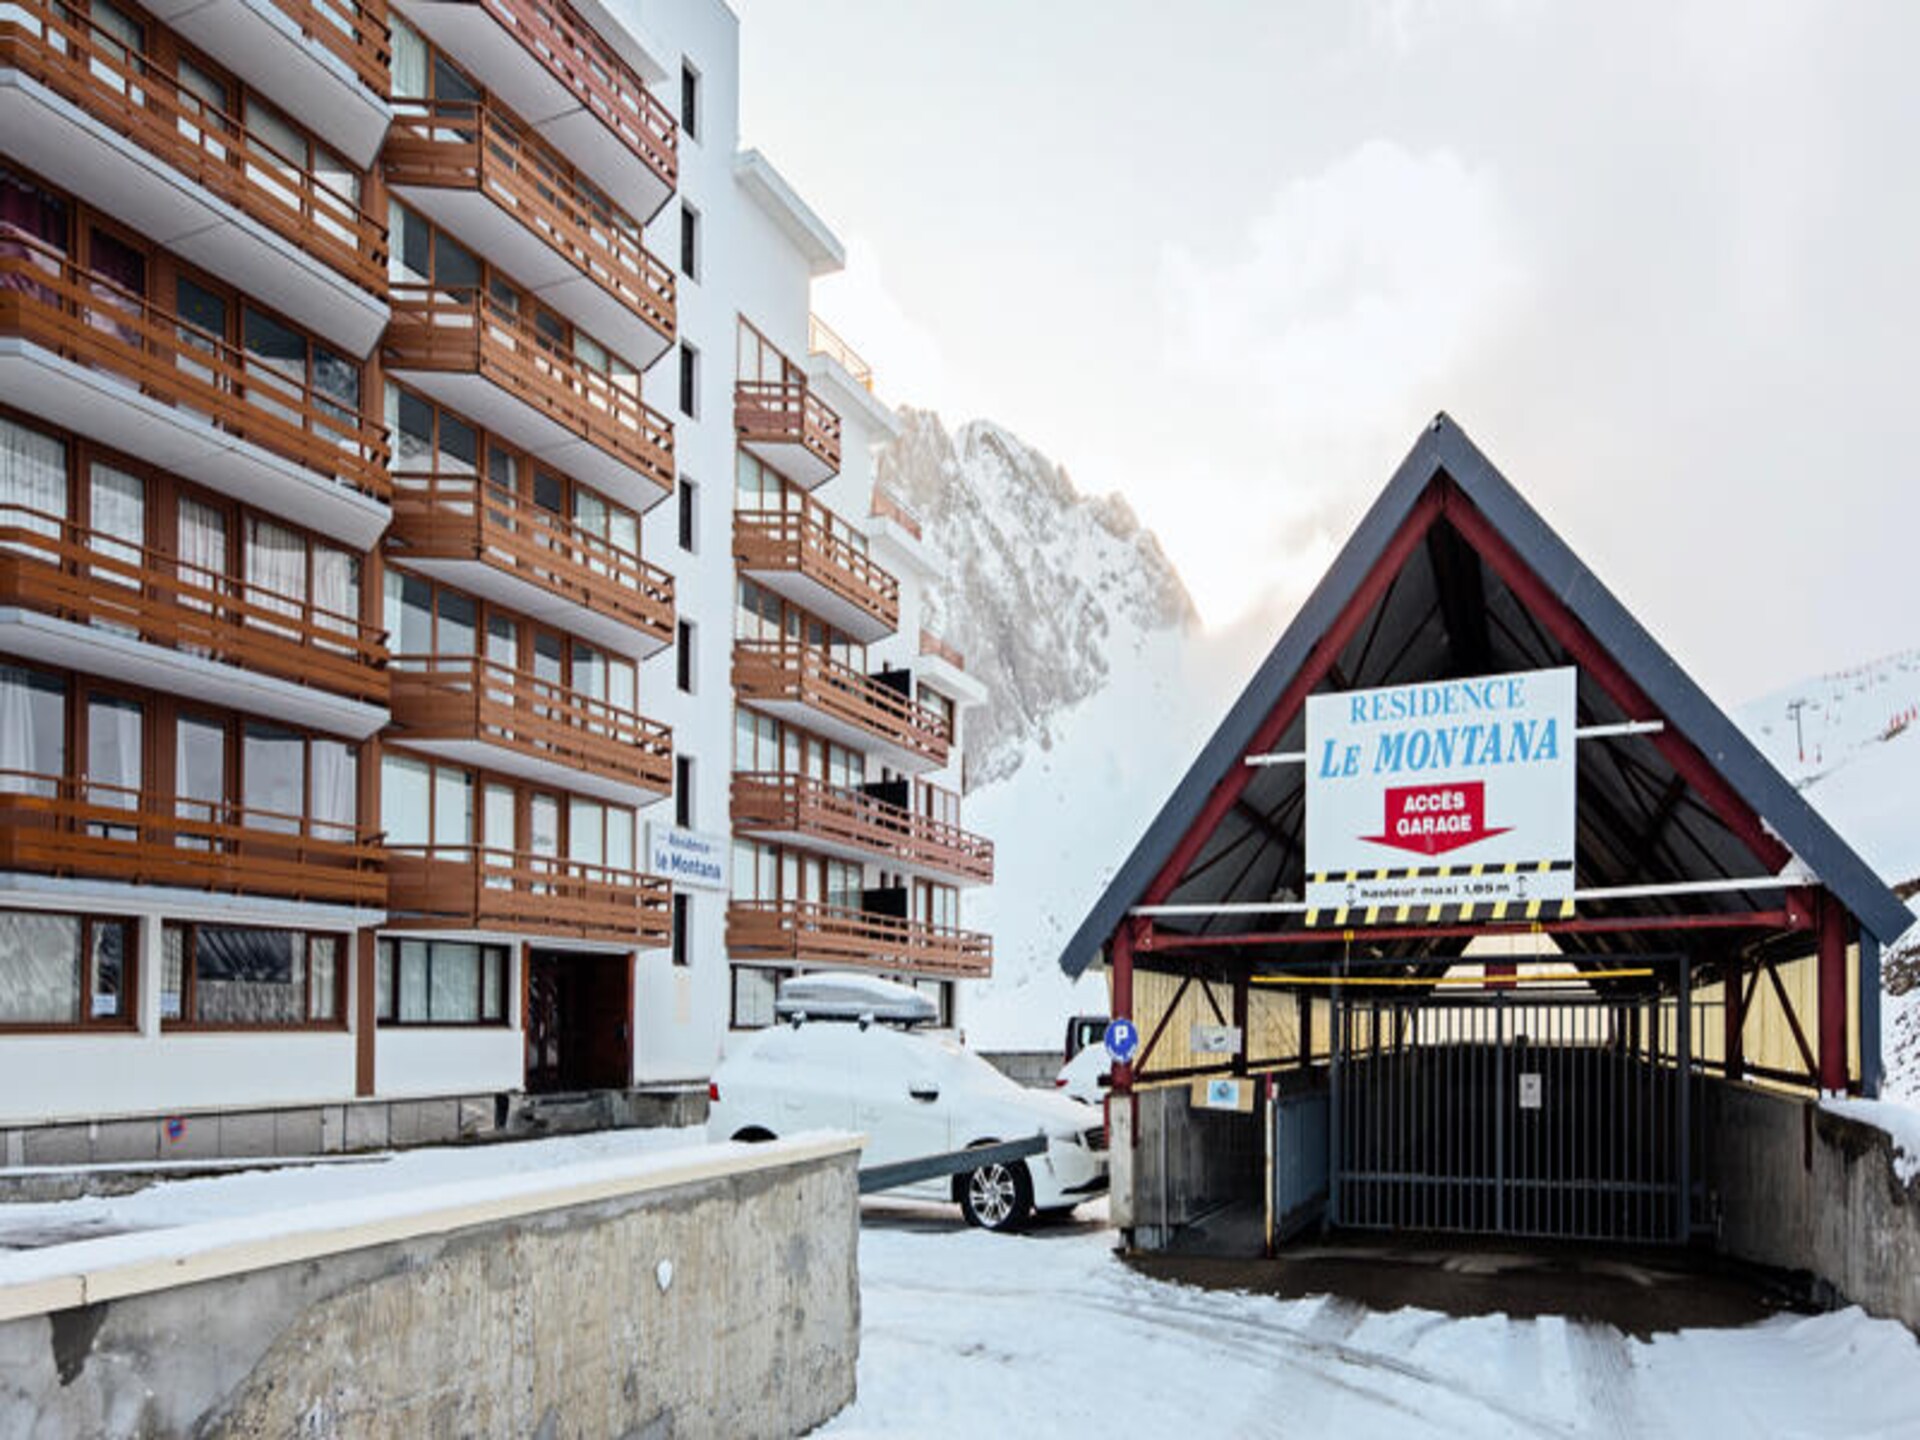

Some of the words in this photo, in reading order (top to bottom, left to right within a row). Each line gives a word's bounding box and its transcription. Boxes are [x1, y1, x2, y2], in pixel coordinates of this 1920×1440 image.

[1351, 678, 1524, 723] RESIDENCE
[1373, 718, 1558, 774] MONTANA
[1396, 814, 1472, 837] GARAGE
[672, 853, 720, 879] Montana
[1115, 1025, 1128, 1046] P
